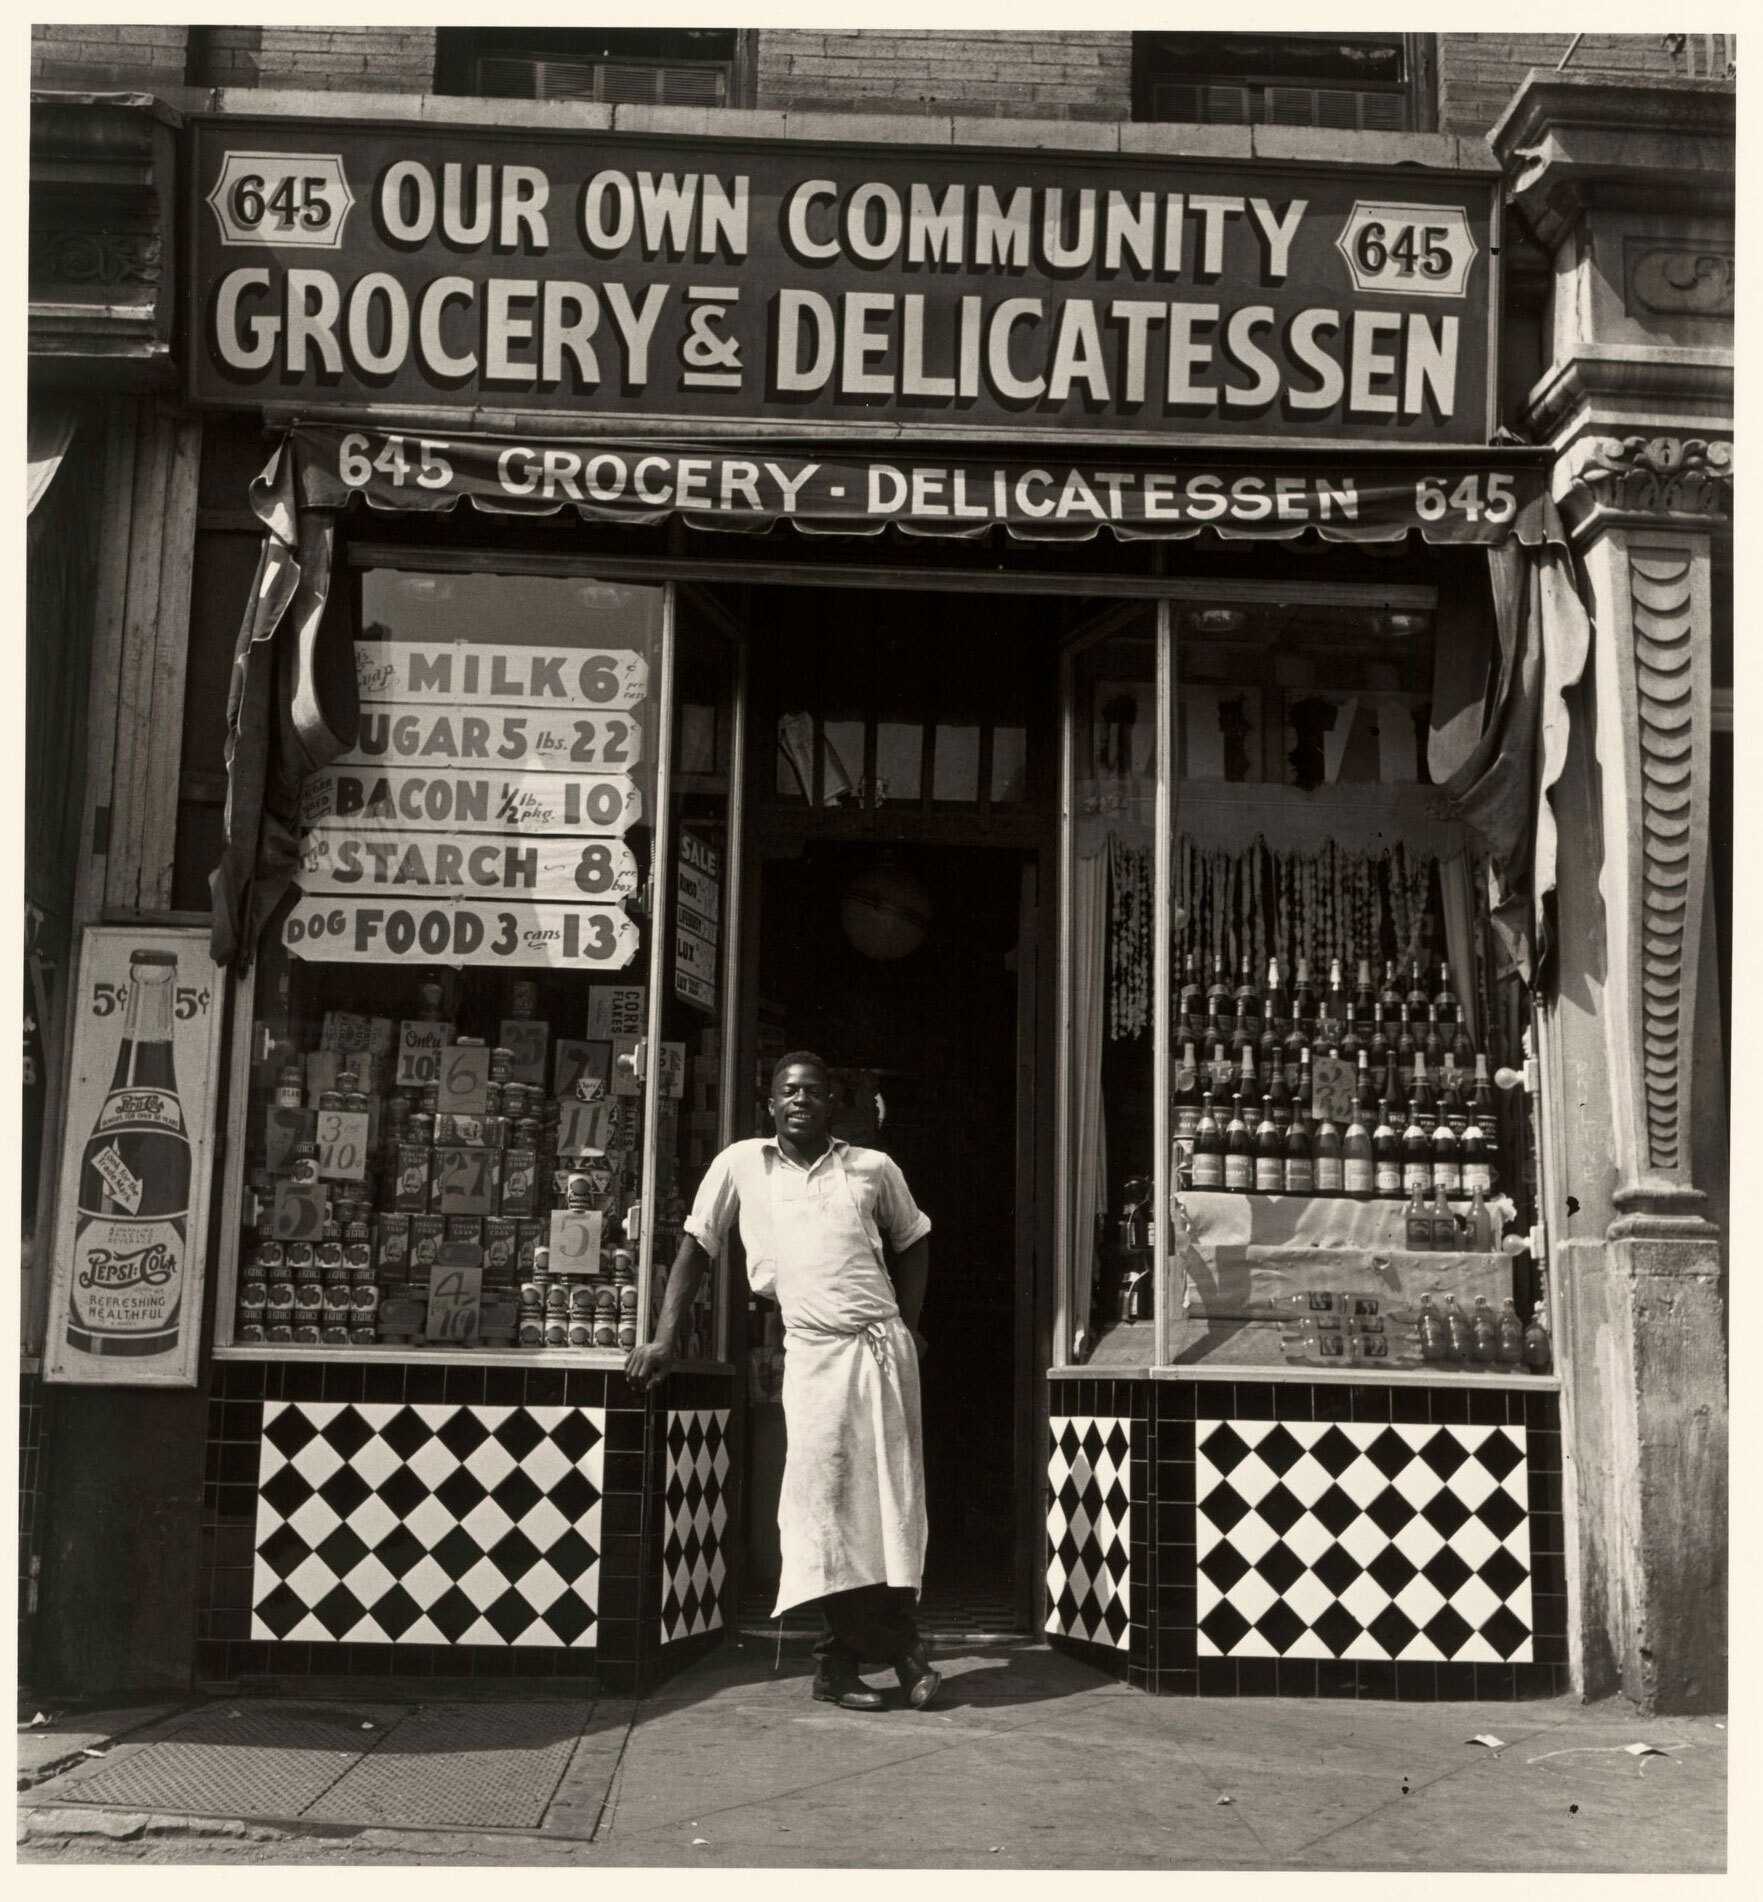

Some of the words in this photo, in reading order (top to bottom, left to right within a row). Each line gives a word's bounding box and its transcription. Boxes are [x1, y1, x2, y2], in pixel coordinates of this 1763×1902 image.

[233, 173, 332, 228] 645
[381, 161, 550, 248] OUR
[583, 170, 750, 255] OWN
[788, 179, 1308, 277] COMMUNITY
[1358, 221, 1454, 279] 645
[215, 267, 670, 386] GROCERY
[682, 300, 742, 376] &
[775, 288, 1459, 417] DELICATESSEN
[338, 433, 453, 490] 645
[498, 446, 820, 512] GROCERY
[867, 464, 1359, 521] DELICATESSEN
[1414, 473, 1517, 523] 645
[407, 652, 568, 698] MILK
[357, 713, 491, 758] UGAR
[497, 718, 528, 761] 5
[535, 731, 568, 752] lbs.
[335, 776, 490, 822] BACON
[331, 840, 539, 889] STARCH
[680, 834, 718, 876] SALE
[611, 879, 633, 892] box
[286, 909, 347, 944] DOG
[355, 909, 485, 955] FOOD
[490, 912, 519, 956] 3
[522, 927, 561, 942] cans
[92, 983, 129, 1018] 5¢
[175, 987, 211, 1021] 5¢
[611, 990, 623, 1035] FLAKES
[623, 990, 640, 1034] CORN
[447, 1054, 479, 1094] 6
[321, 1115, 341, 1142] 3
[560, 1223, 591, 1258] 5
[88, 1295, 167, 1307] REFRESHING
[88, 1307, 163, 1321] HEALTHFUL
